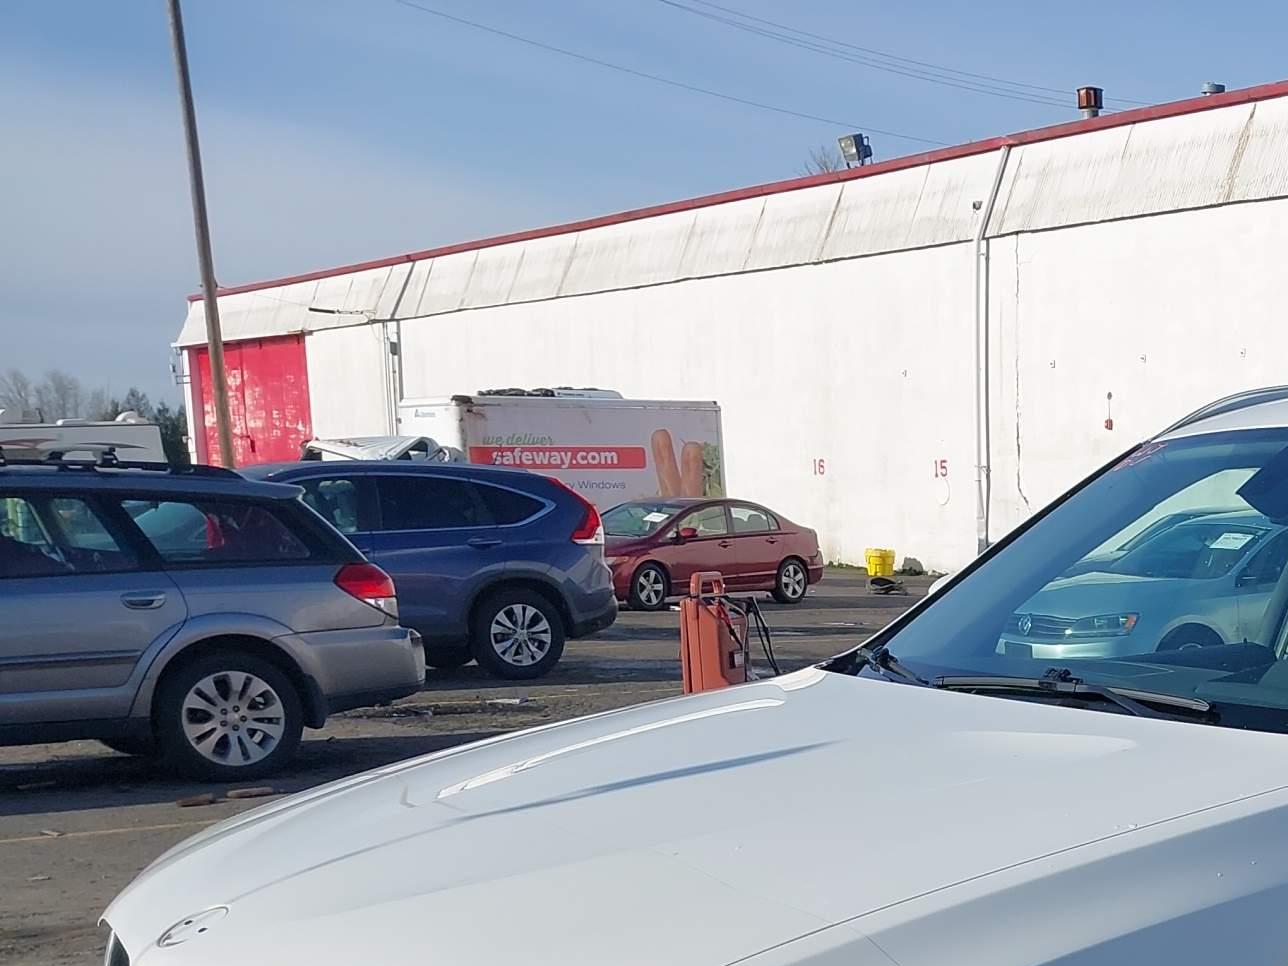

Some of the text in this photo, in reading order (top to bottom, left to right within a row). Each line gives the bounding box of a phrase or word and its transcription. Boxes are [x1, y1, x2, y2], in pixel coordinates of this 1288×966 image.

[492, 447, 618, 469] safeway.com
[813, 459, 825, 475] 16
[934, 459, 948, 478] 15
[579, 480, 627, 489] Windows
